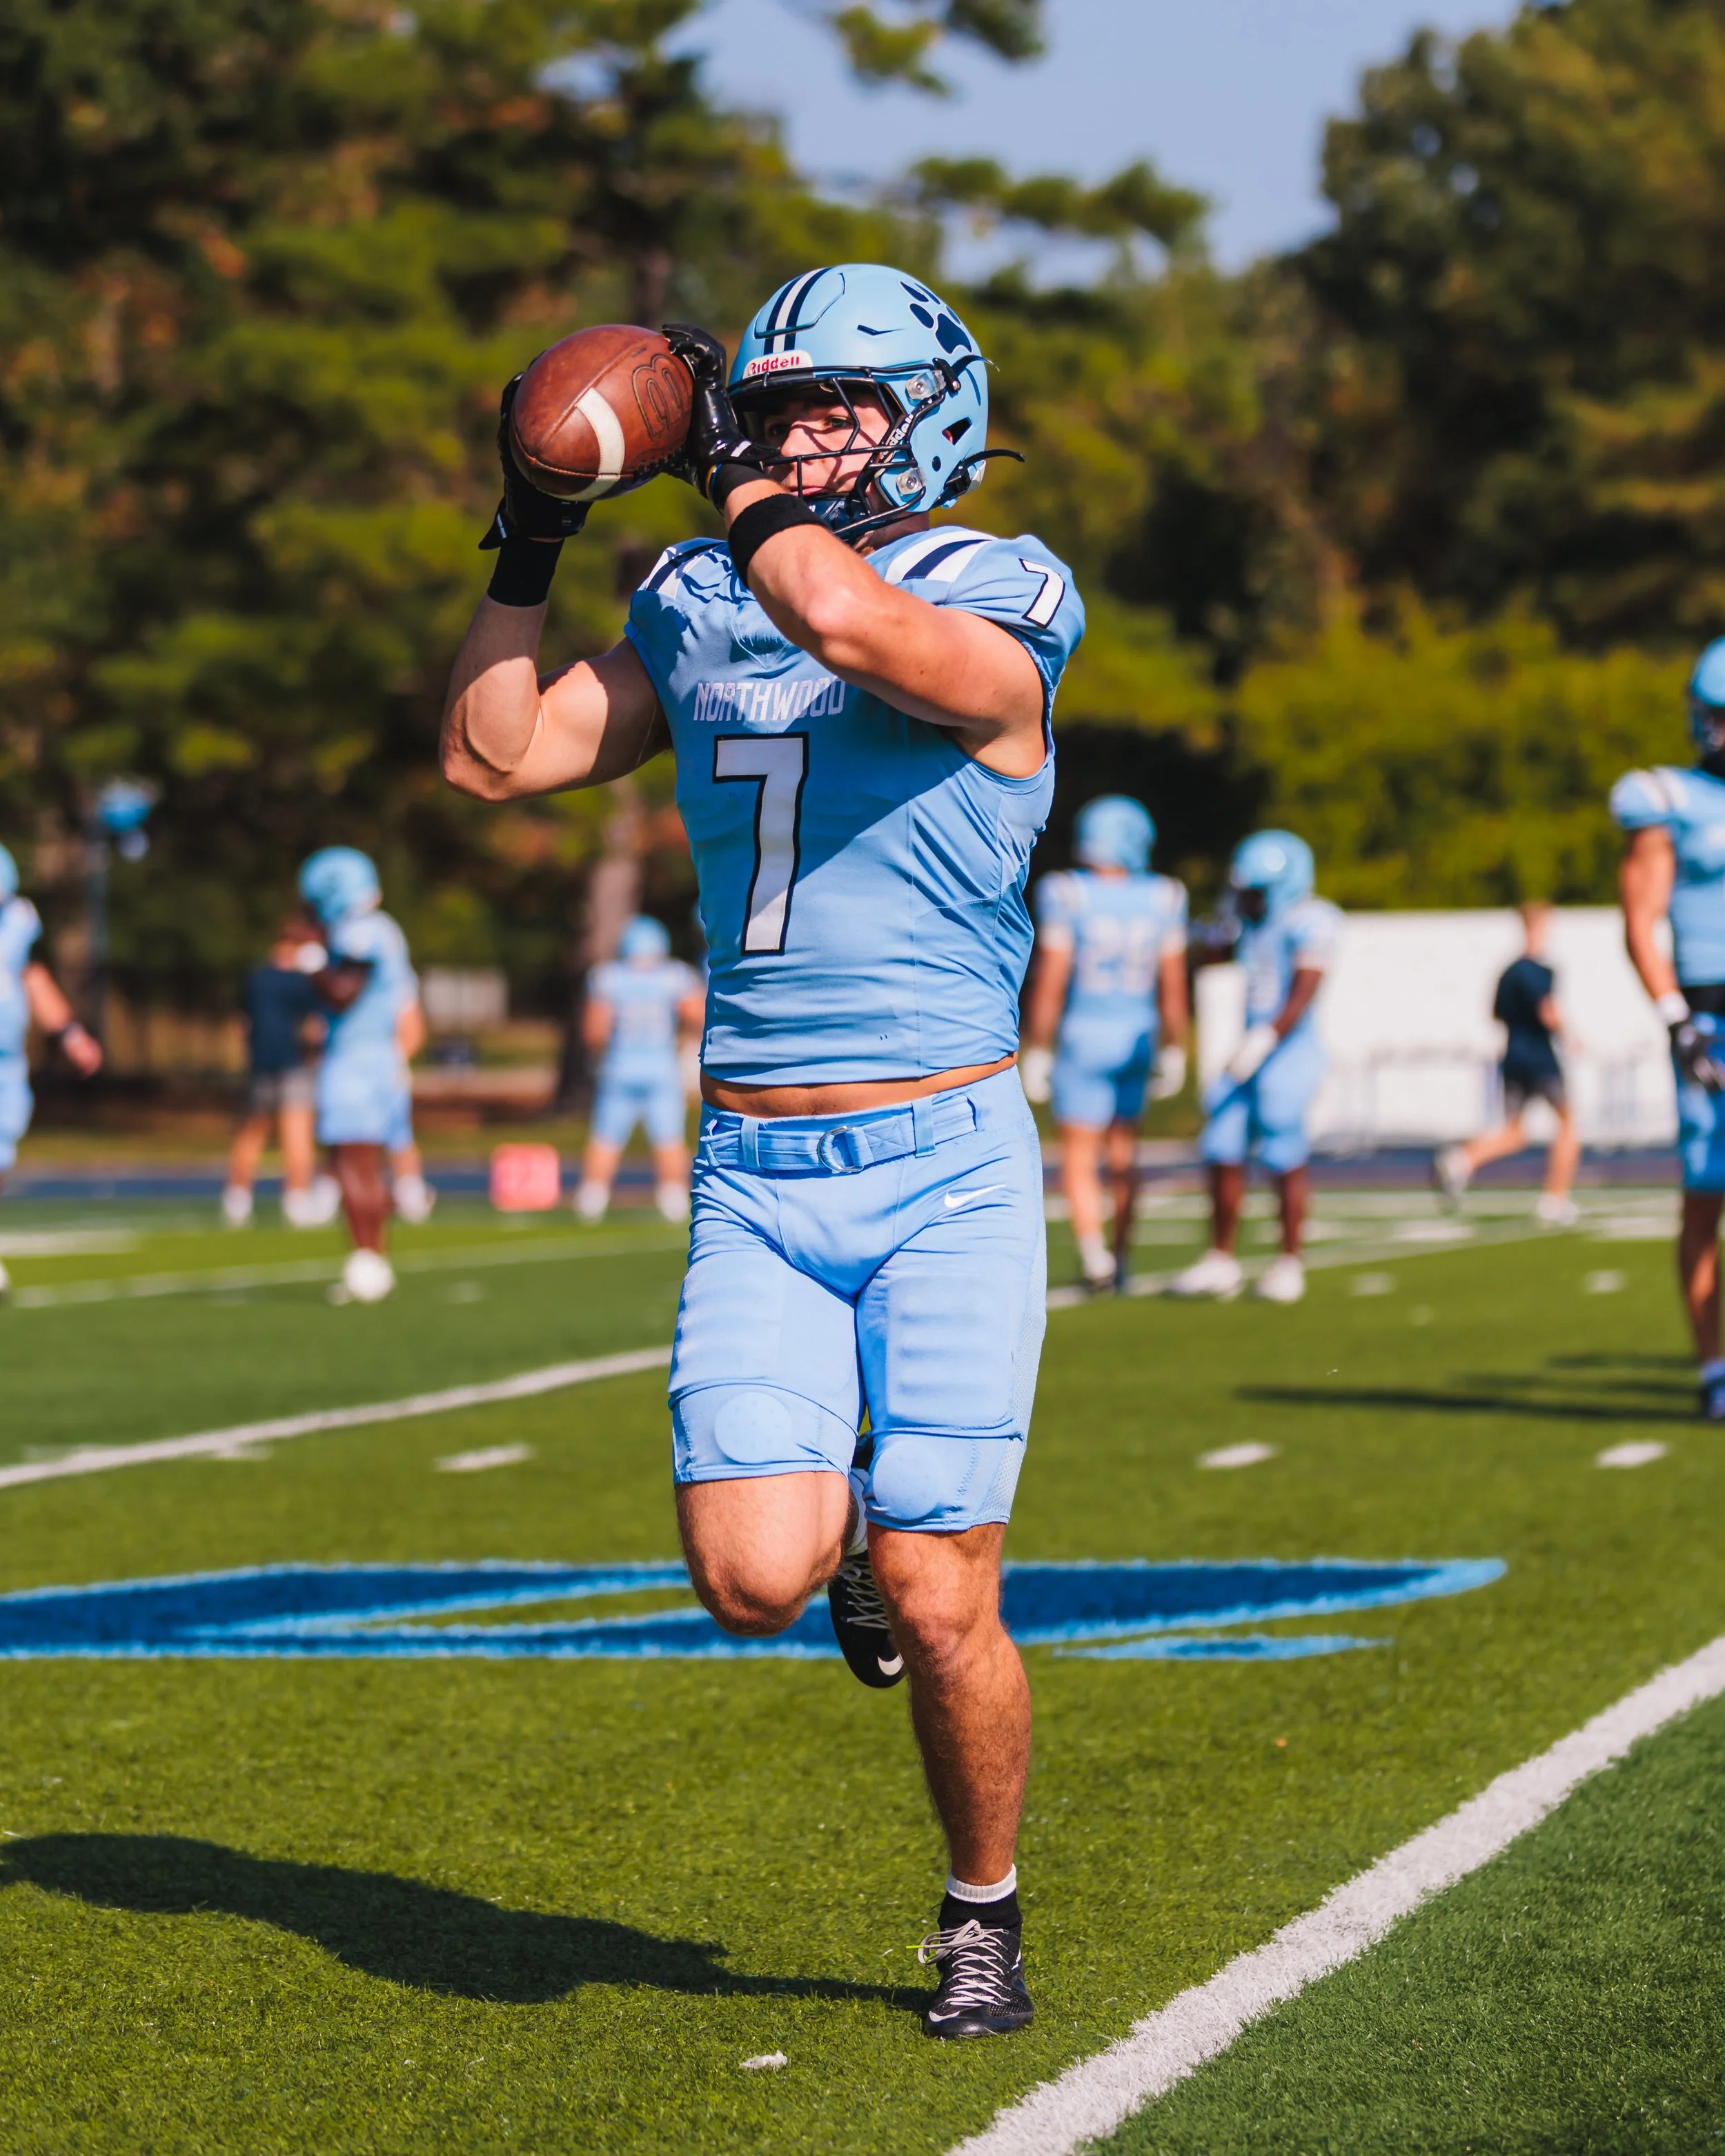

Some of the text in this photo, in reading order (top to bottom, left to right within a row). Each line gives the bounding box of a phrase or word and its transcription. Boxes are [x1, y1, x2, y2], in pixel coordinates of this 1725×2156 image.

[749, 356, 799, 374] Riddell
[1018, 557, 1065, 629] 7
[693, 675, 845, 722] NORTHWOOD
[712, 731, 809, 956] 7
